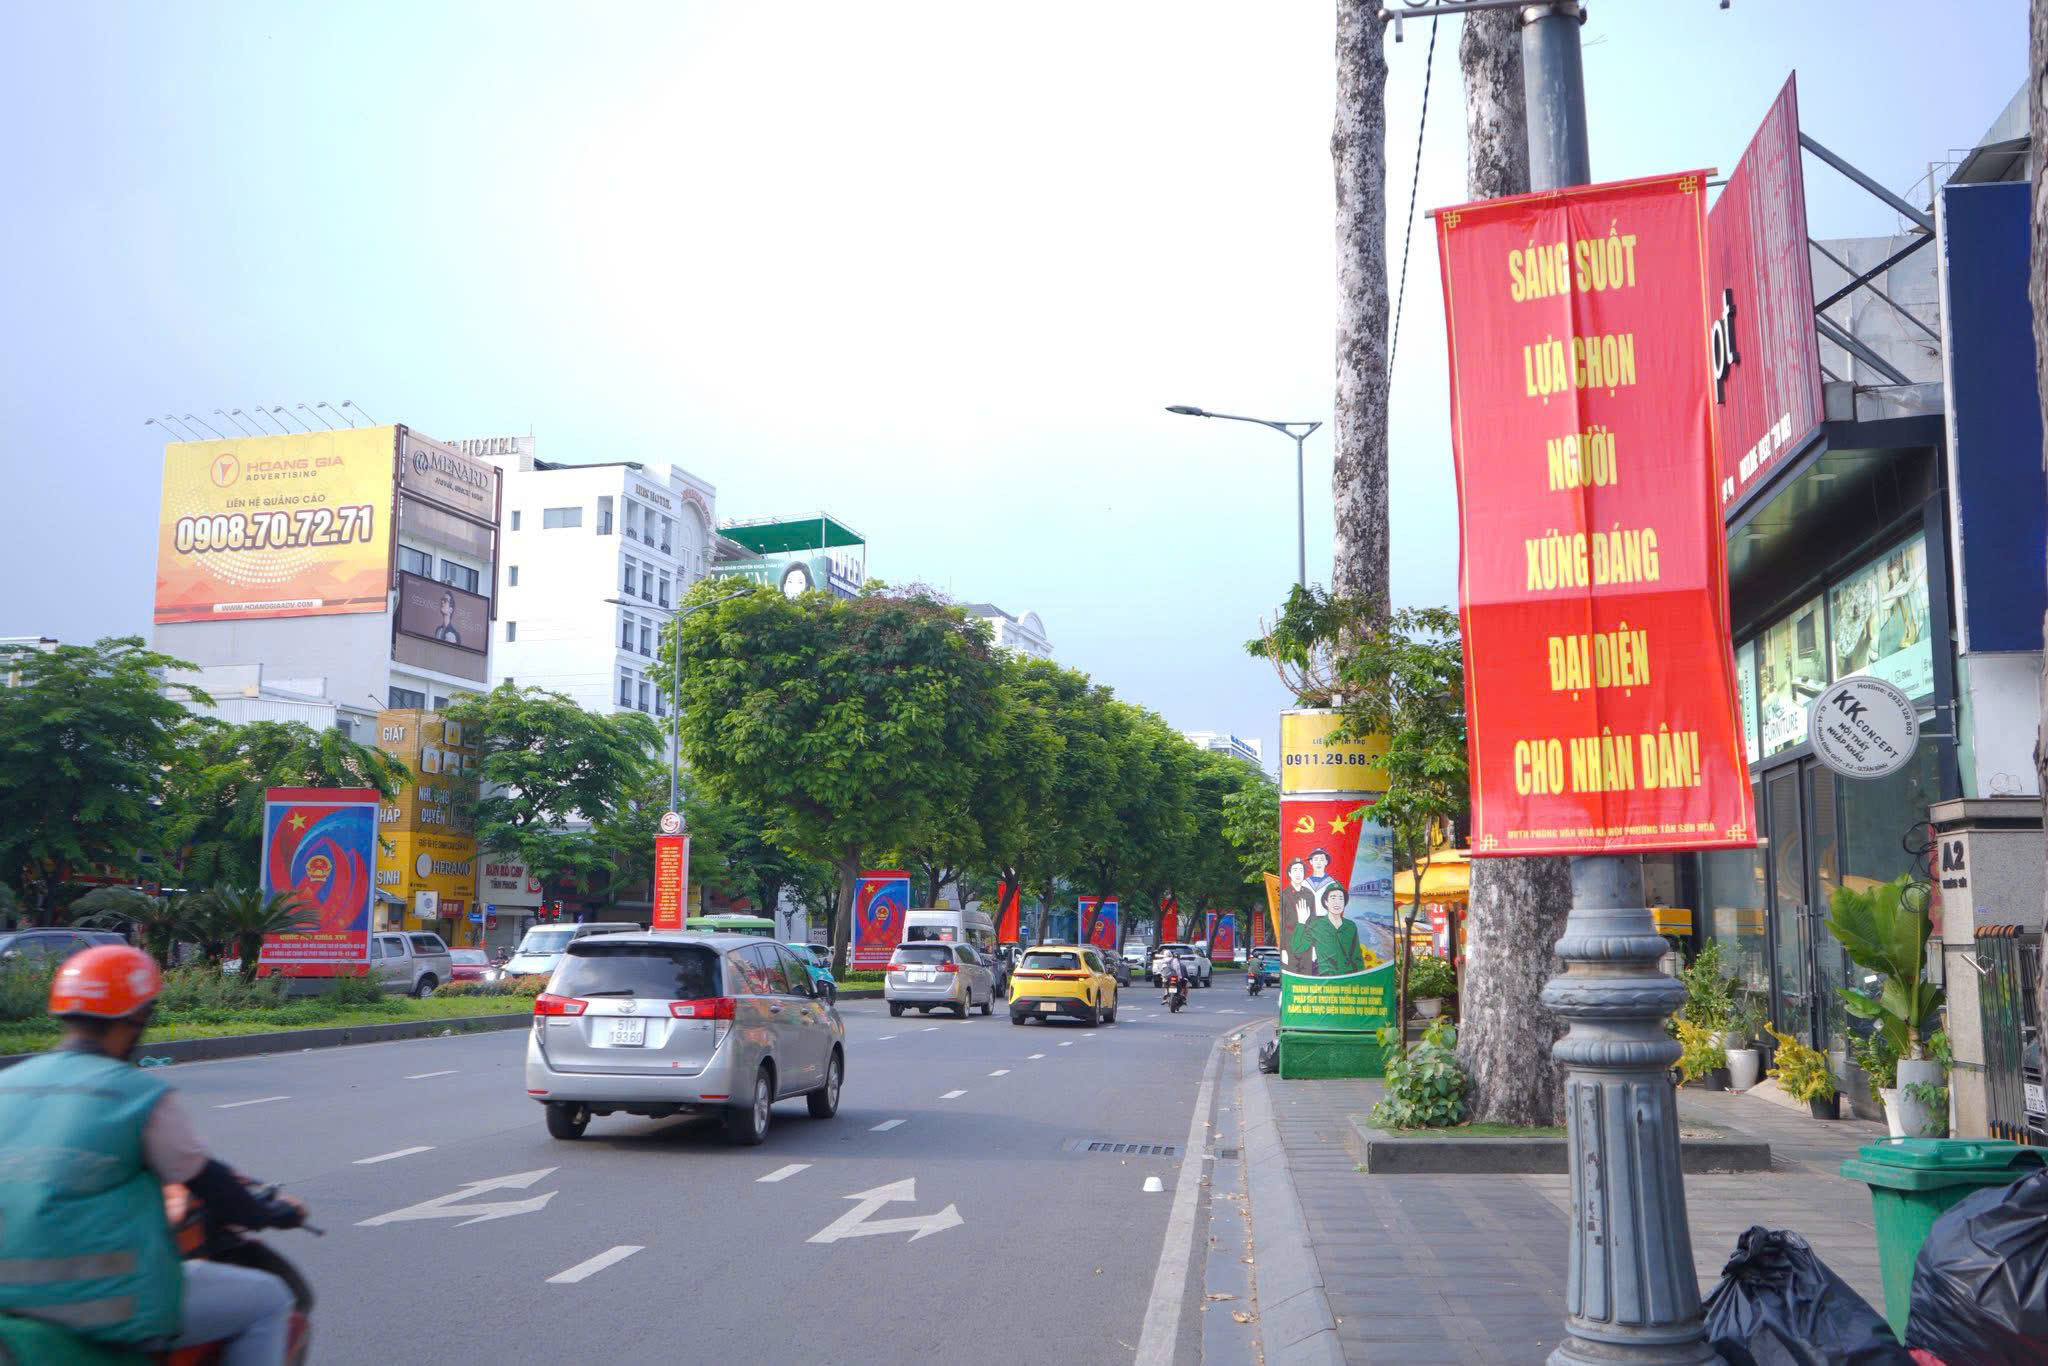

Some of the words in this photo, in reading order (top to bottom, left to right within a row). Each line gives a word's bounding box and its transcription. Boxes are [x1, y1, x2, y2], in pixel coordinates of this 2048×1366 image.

[1508, 240, 1570, 303] SÁNG
[1576, 219, 1637, 294] SUỐT
[1524, 334, 1568, 406] LỰA
[1571, 334, 1637, 398] CHỌN
[461, 437, 519, 457] HOTEL
[1547, 424, 1618, 492] NGƯỜI
[246, 459, 308, 473] HOANG
[315, 456, 345, 469] GIA
[246, 470, 318, 481] ADVERTISING
[431, 451, 488, 489] MENARD
[226, 497, 245, 508] LIÊN
[249, 495, 260, 508] HỆ
[263, 494, 300, 507] QUẢNG
[303, 493, 326, 504] CÁO
[650, 491, 672, 510] HOTEL
[176, 505, 374, 554] 0908.70.72.71
[1525, 529, 1589, 591] XỨNG
[1592, 522, 1660, 585] ĐÁNG
[1548, 634, 1591, 701] ĐẠI
[1594, 620, 1650, 698] DIỆN
[1857, 683, 1886, 695] Hotline:
[384, 724, 405, 743] GIẶT
[1764, 711, 1799, 744] FURNITURE
[1832, 689, 1868, 723] KK
[1855, 719, 1899, 759] CONCEPT
[1838, 722, 1853, 736] NỘI
[1851, 732, 1870, 752] THẤT
[1514, 738, 1564, 796] CHO
[1570, 726, 1635, 793] NHÂN
[1640, 722, 1701, 789] DÂN!
[1827, 726, 1846, 745] NHẬP
[1844, 743, 1865, 763] KHẨU
[1874, 763, 1889, 771] BÌNH
[1660, 823, 1677, 833] TÂN
[432, 860, 472, 877] HERAMO
[1943, 841, 1965, 872] A2
[377, 870, 401, 885] SINH
[617, 1019, 638, 1031] 51H
